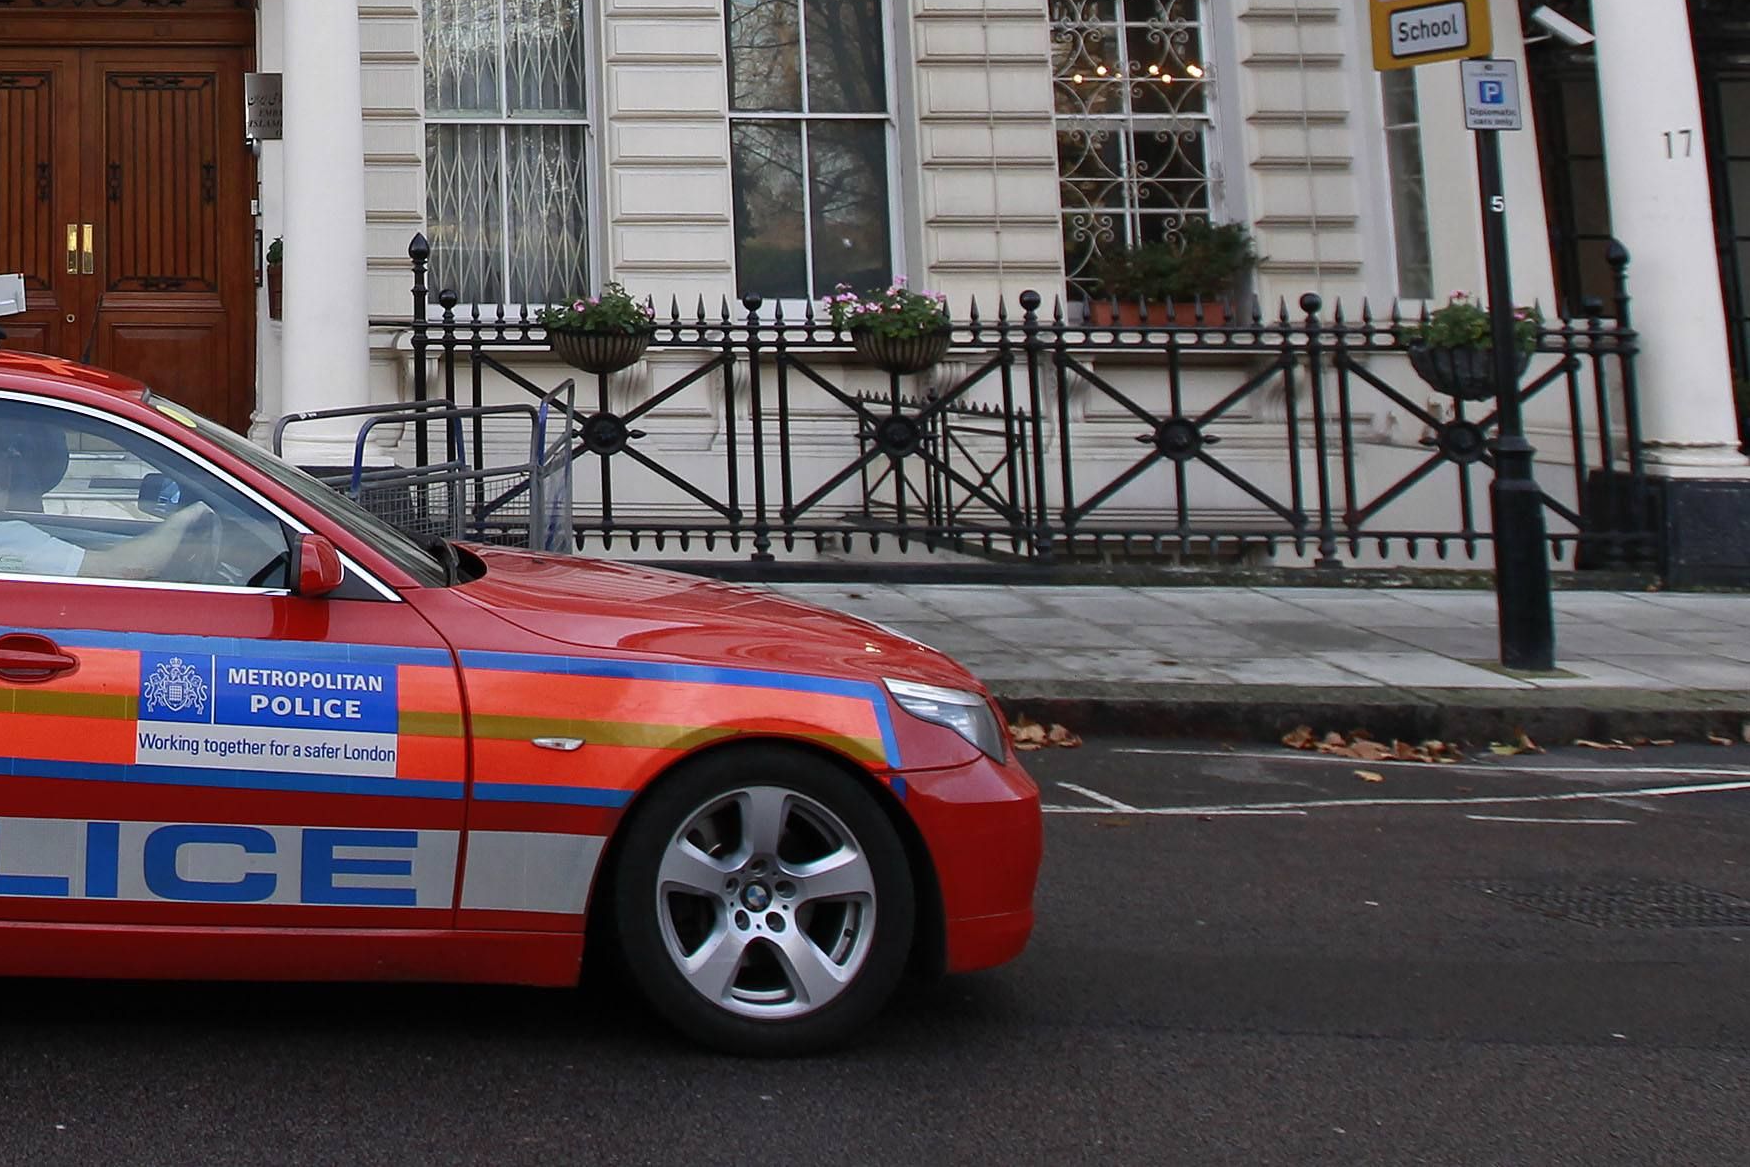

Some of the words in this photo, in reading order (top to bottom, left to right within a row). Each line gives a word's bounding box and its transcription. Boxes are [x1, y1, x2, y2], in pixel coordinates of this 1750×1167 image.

[1397, 14, 1459, 43] School
[1484, 82, 1500, 102] P
[1469, 107, 1517, 116] Diplomatic
[1662, 129, 1692, 159] 17
[1491, 195, 1504, 212] 5
[227, 667, 383, 692] METROPOLITAN
[249, 694, 363, 719] POLICE
[138, 733, 200, 756] Working
[203, 736, 268, 757] together
[269, 739, 291, 757] for
[292, 744, 301, 757] a
[304, 740, 341, 760] safer
[343, 742, 396, 763] London
